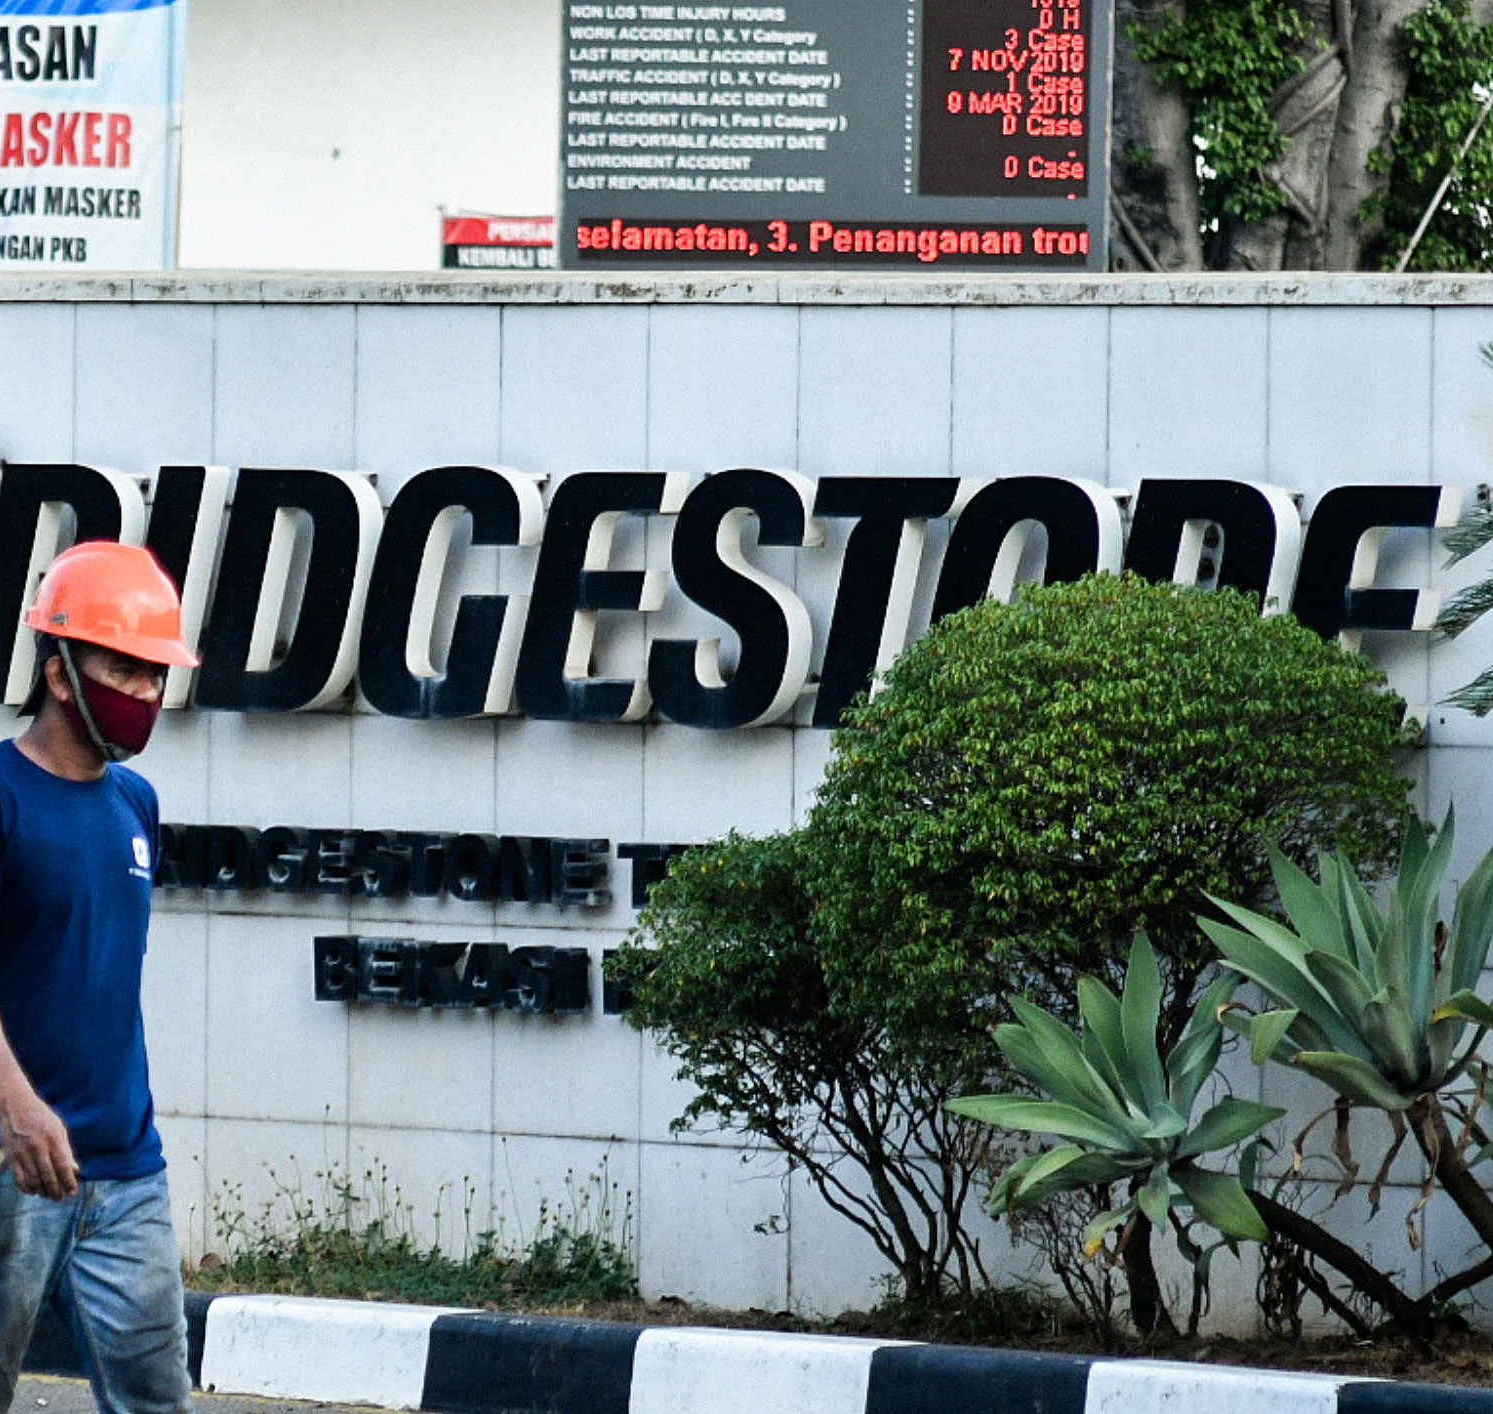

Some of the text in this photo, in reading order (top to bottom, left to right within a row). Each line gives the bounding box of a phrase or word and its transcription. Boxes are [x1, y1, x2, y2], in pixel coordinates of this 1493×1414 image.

[570, 5, 787, 21] NON LOS TIME INJURY HOURS
[1063, 8, 1080, 30] H
[570, 26, 617, 40] WORK
[618, 27, 694, 41] ACCIDENT
[753, 29, 818, 46] Category
[1005, 28, 1084, 51] 3 Case
[570, 48, 828, 65] LAST REPORTABLE ACCIDENT DATE
[948, 48, 1084, 73] 7 NOV 2019
[569, 69, 632, 83] TRAFFIC
[634, 70, 709, 84] ACCIDENT
[1007, 71, 1084, 95] 1 Case
[568, 91, 607, 104] LAST
[609, 91, 708, 106] REPORTABLE
[788, 93, 828, 107] DATE
[968, 91, 1022, 114] MAR
[1029, 93, 1084, 115] 2019
[567, 111, 603, 125] FIRE
[604, 112, 680, 126] ACCIDENT
[1026, 114, 1084, 137] Case
[567, 133, 827, 150] LAST REPORTABLE ACCIDENT DATE
[567, 154, 752, 170] ENVIRONMENT ACCIDENT
[1028, 155, 1084, 179] Case
[567, 175, 826, 193] LAST REPORTABLE ACCIDENT DATE
[43, 187, 141, 219] MASKER
[50, 237, 87, 262] PKB
[767, 220, 798, 252] 3.
[809, 220, 1022, 262] Penanganan
[155, 823, 612, 905] RIDGESTONE
[313, 935, 590, 1013] BEKASI
